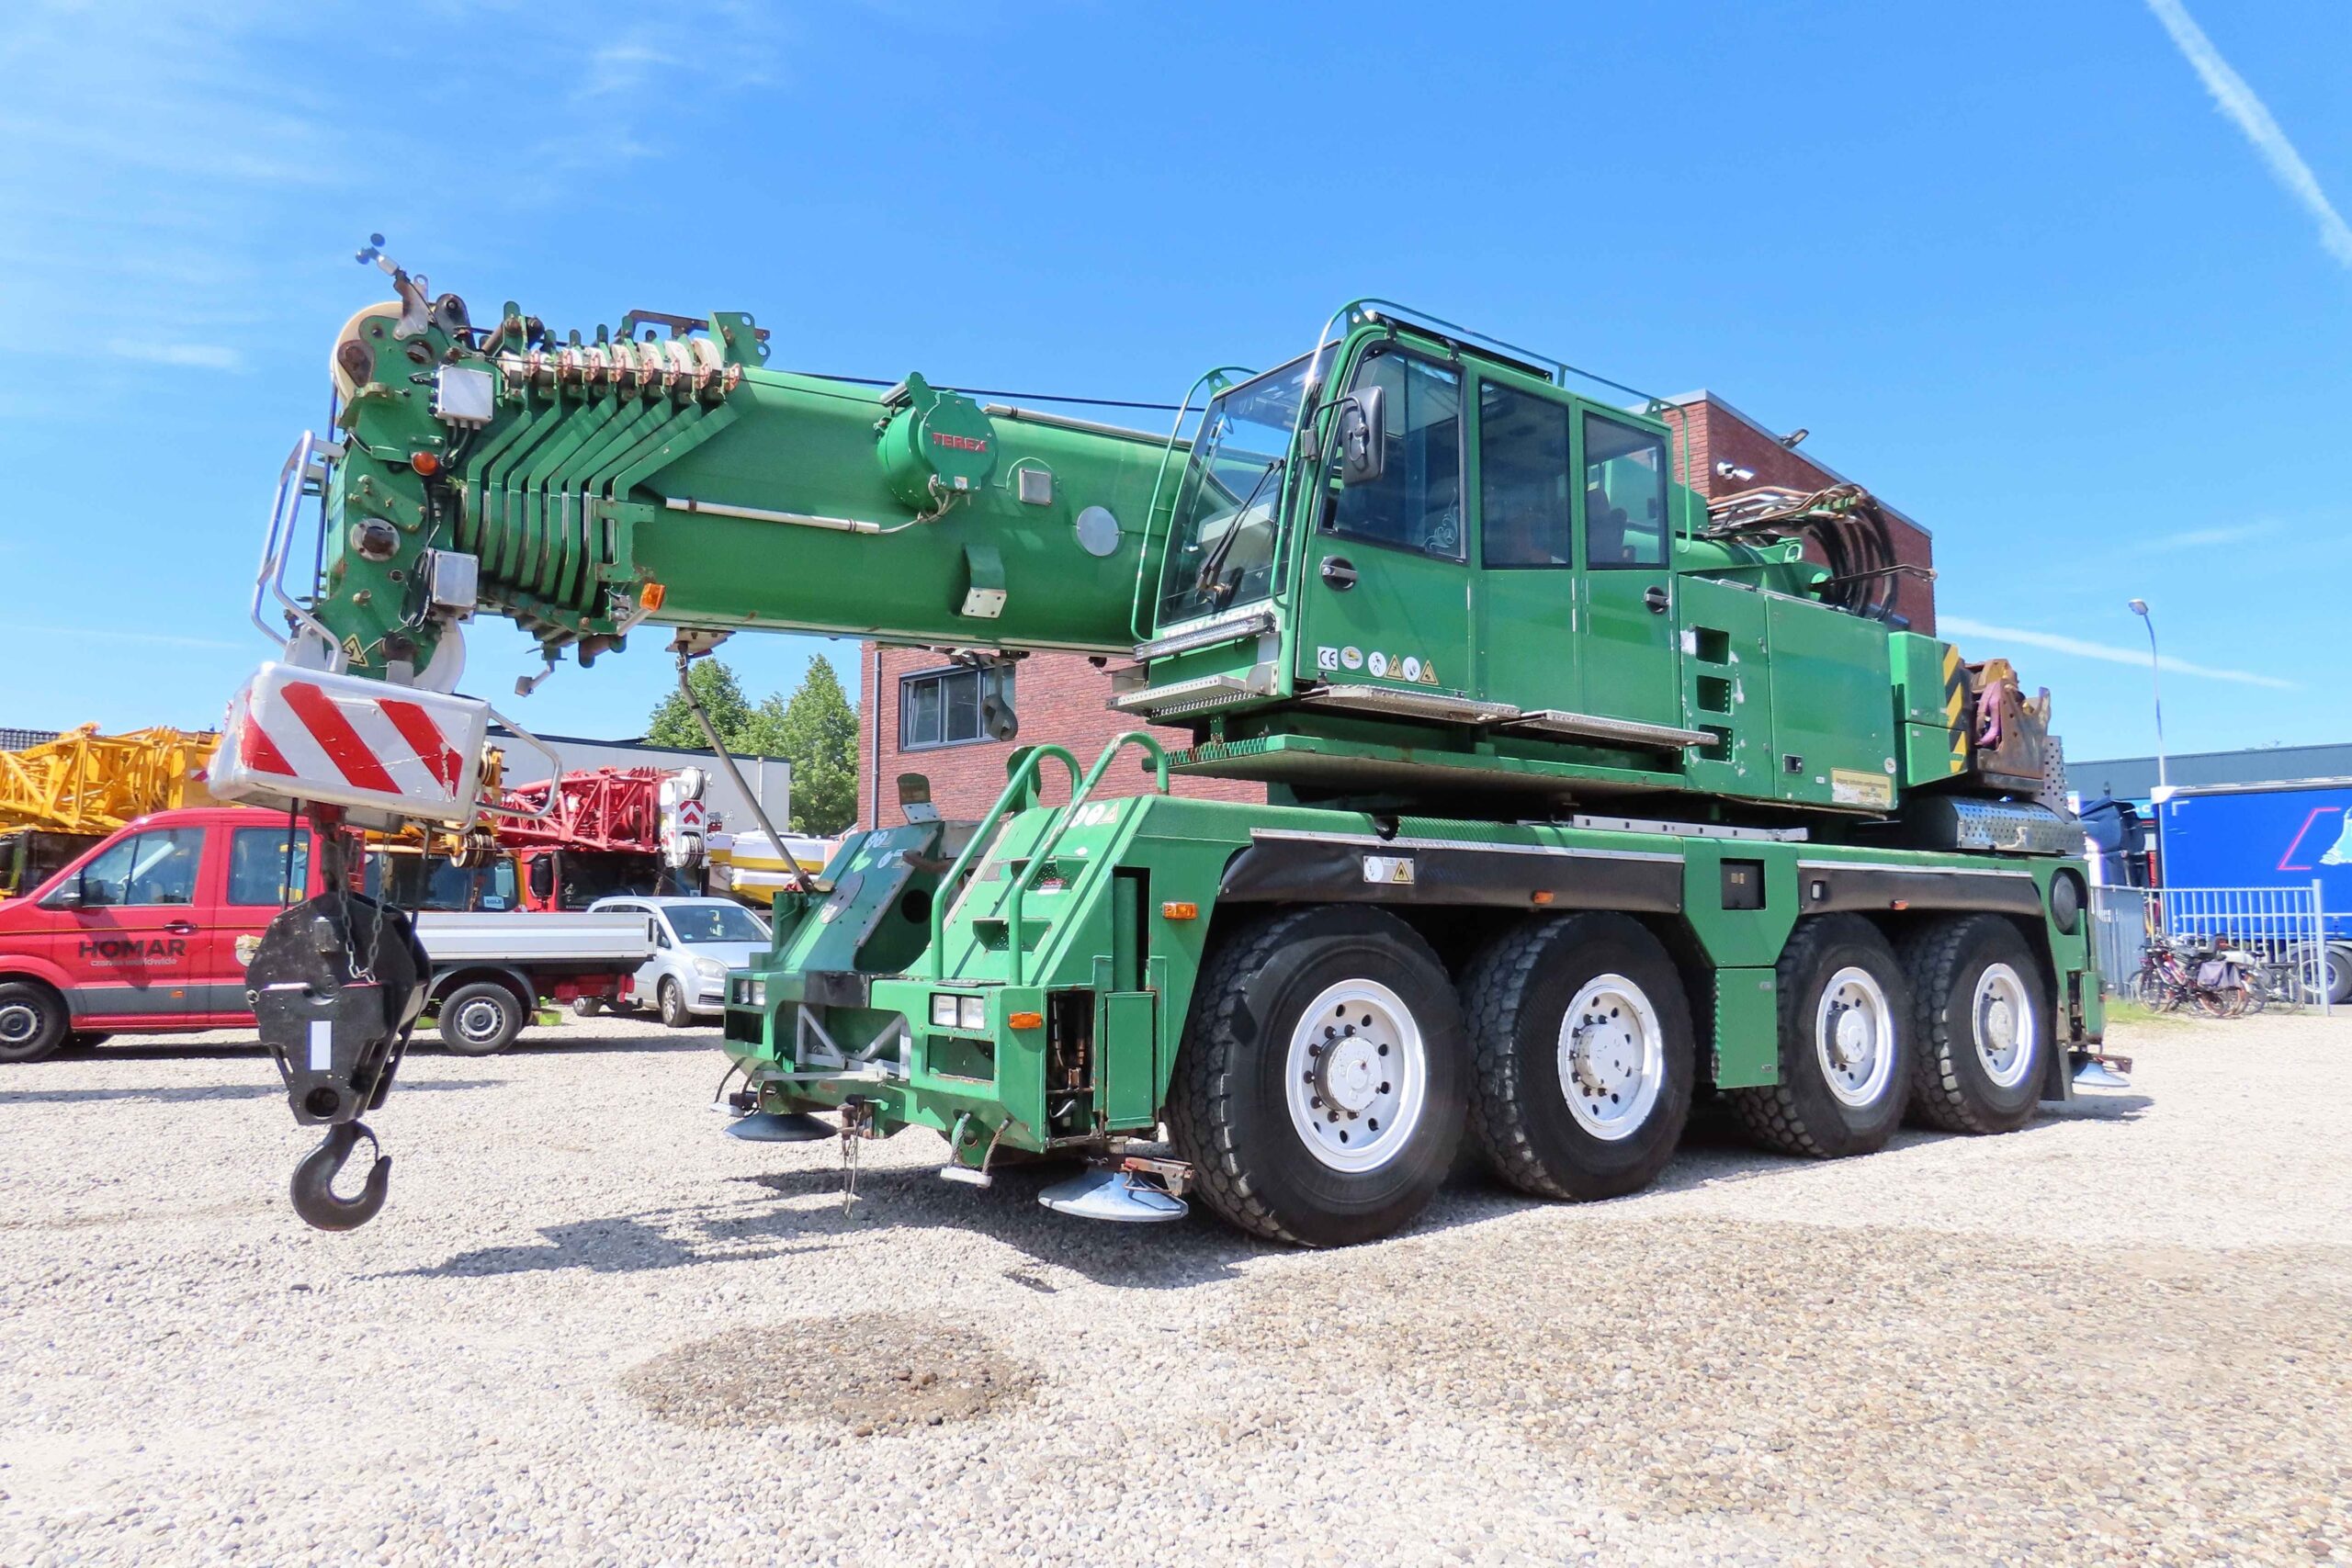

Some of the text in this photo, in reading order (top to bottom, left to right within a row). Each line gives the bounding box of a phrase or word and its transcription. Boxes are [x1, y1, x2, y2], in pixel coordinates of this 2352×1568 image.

[933, 432, 988, 453] TEREX
[1319, 649, 1337, 668] CE
[78, 939, 187, 958] HOMAR
